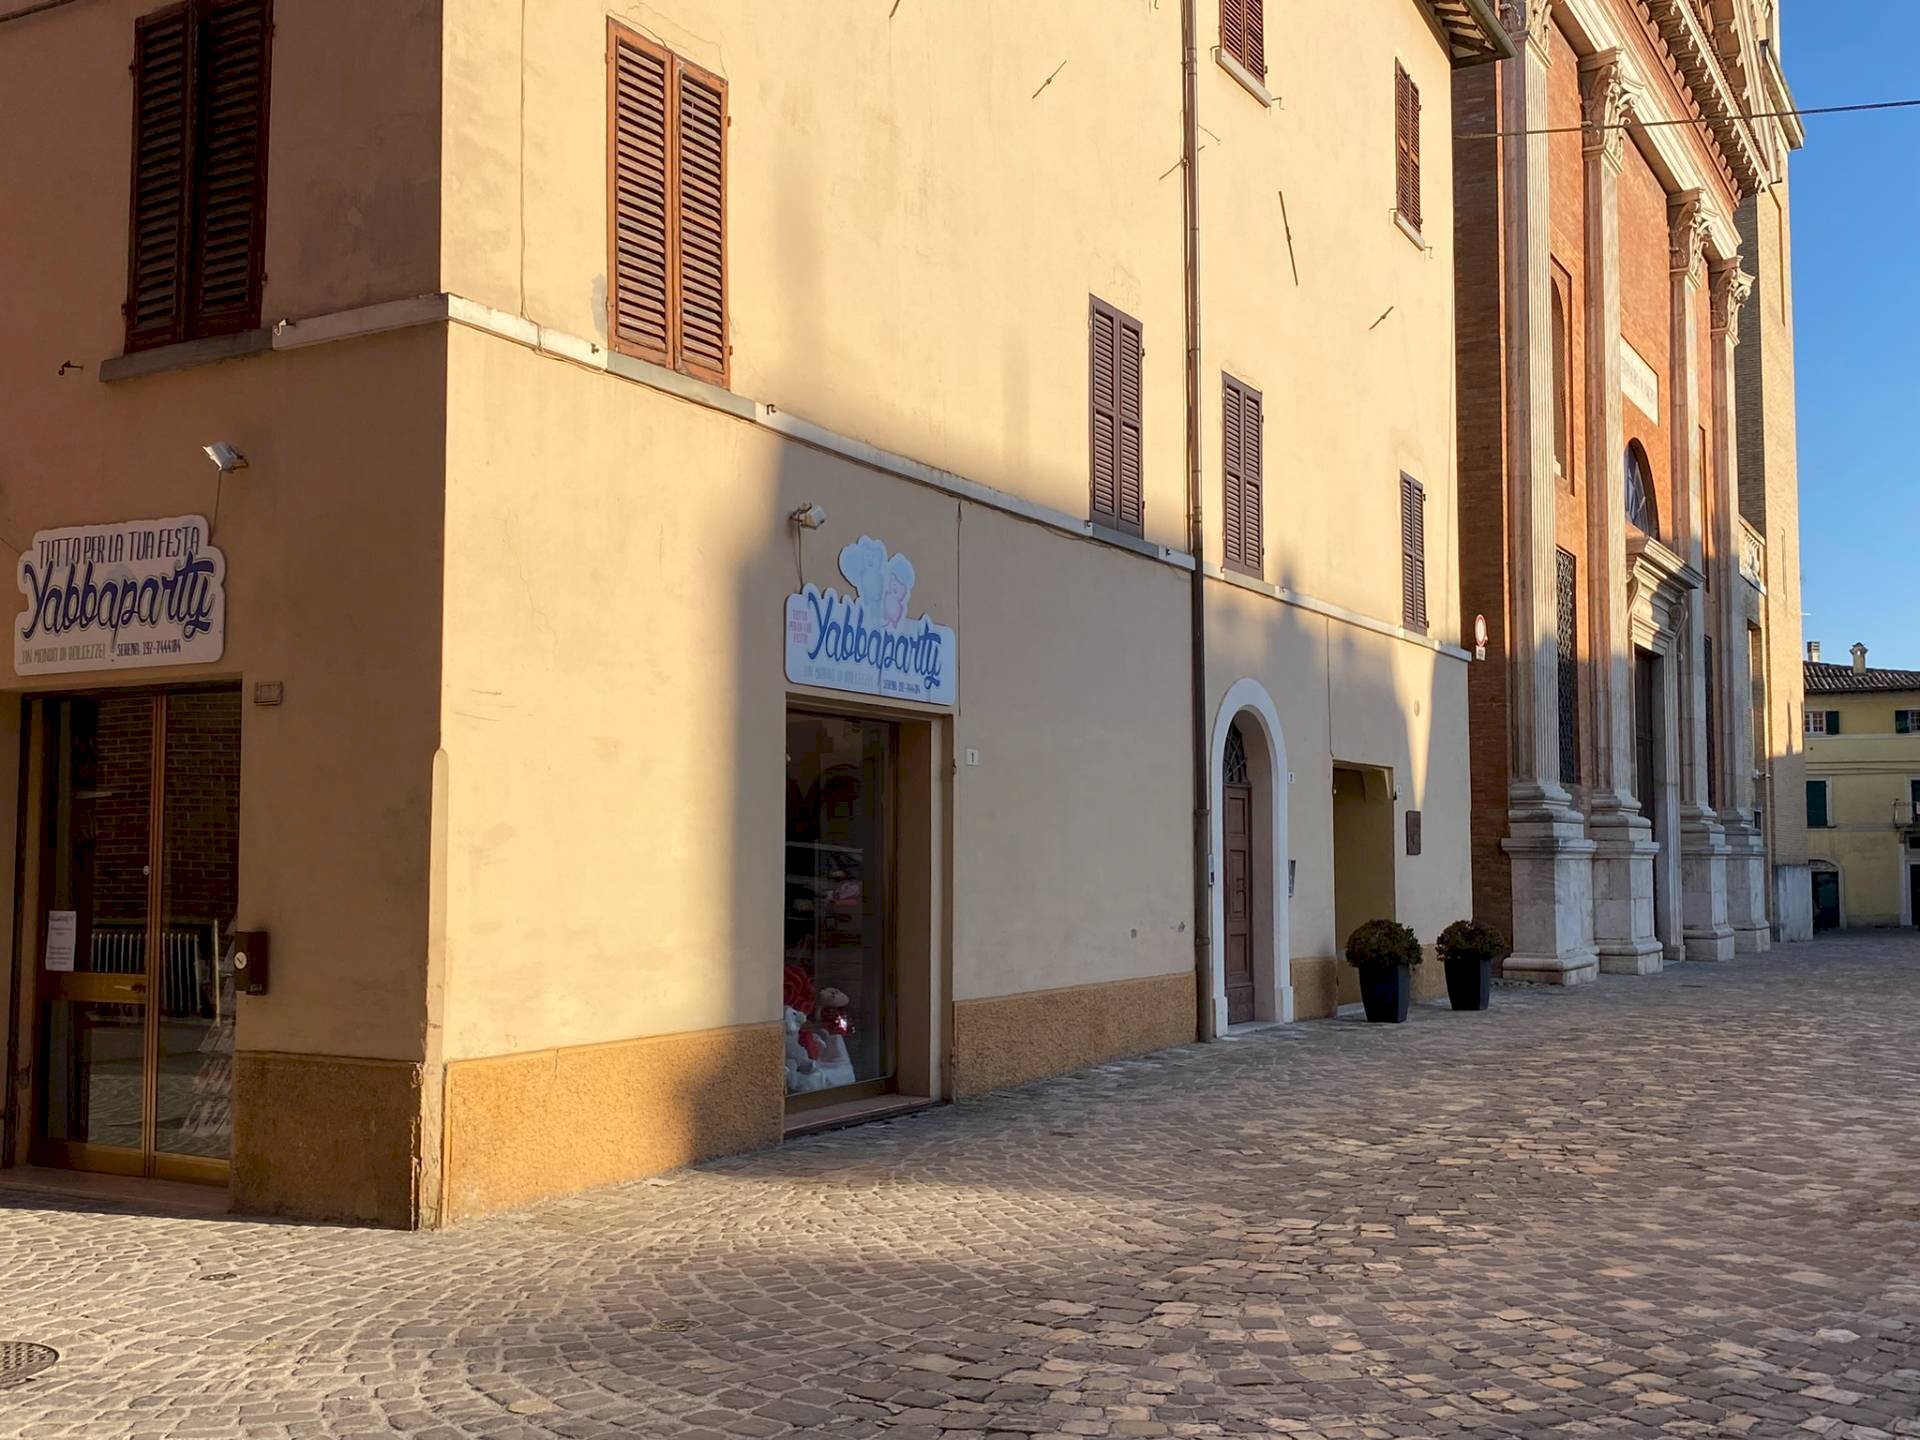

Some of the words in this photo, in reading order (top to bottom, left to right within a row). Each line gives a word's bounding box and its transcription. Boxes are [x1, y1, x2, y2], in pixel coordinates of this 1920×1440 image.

[38, 537, 81, 569] TUTTO
[84, 535, 105, 564] PER
[108, 534, 124, 563] LA
[128, 530, 154, 561] TUA
[158, 527, 200, 557] FESTA
[21, 549, 215, 650] Yabbaparty
[807, 591, 943, 690] Yabbaparty
